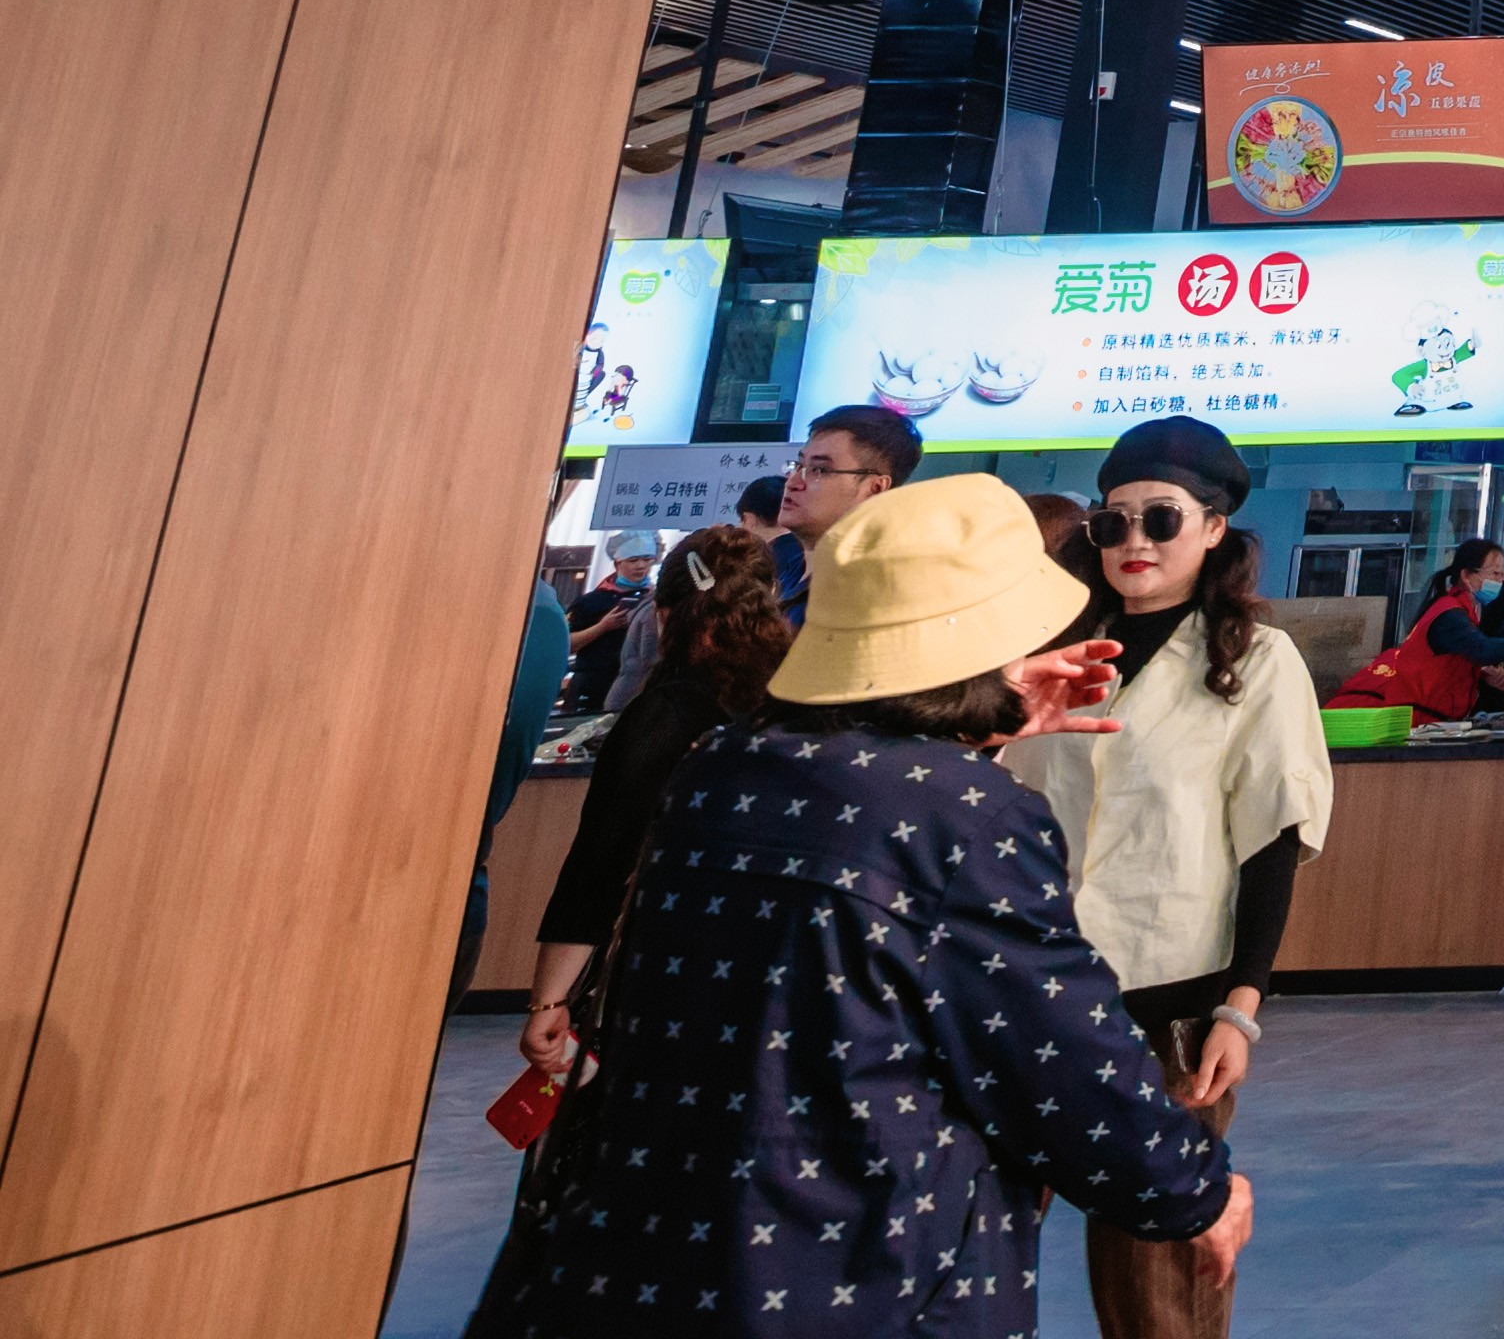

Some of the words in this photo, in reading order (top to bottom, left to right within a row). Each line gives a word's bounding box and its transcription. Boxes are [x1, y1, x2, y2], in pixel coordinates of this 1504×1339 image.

[1374, 60, 1454, 118] 凉皮
[1051, 261, 1157, 315] 爱菊
[1188, 262, 1305, 310] 汤圆
[719, 452, 770, 469] 价格表
[649, 481, 709, 498] 今日特供
